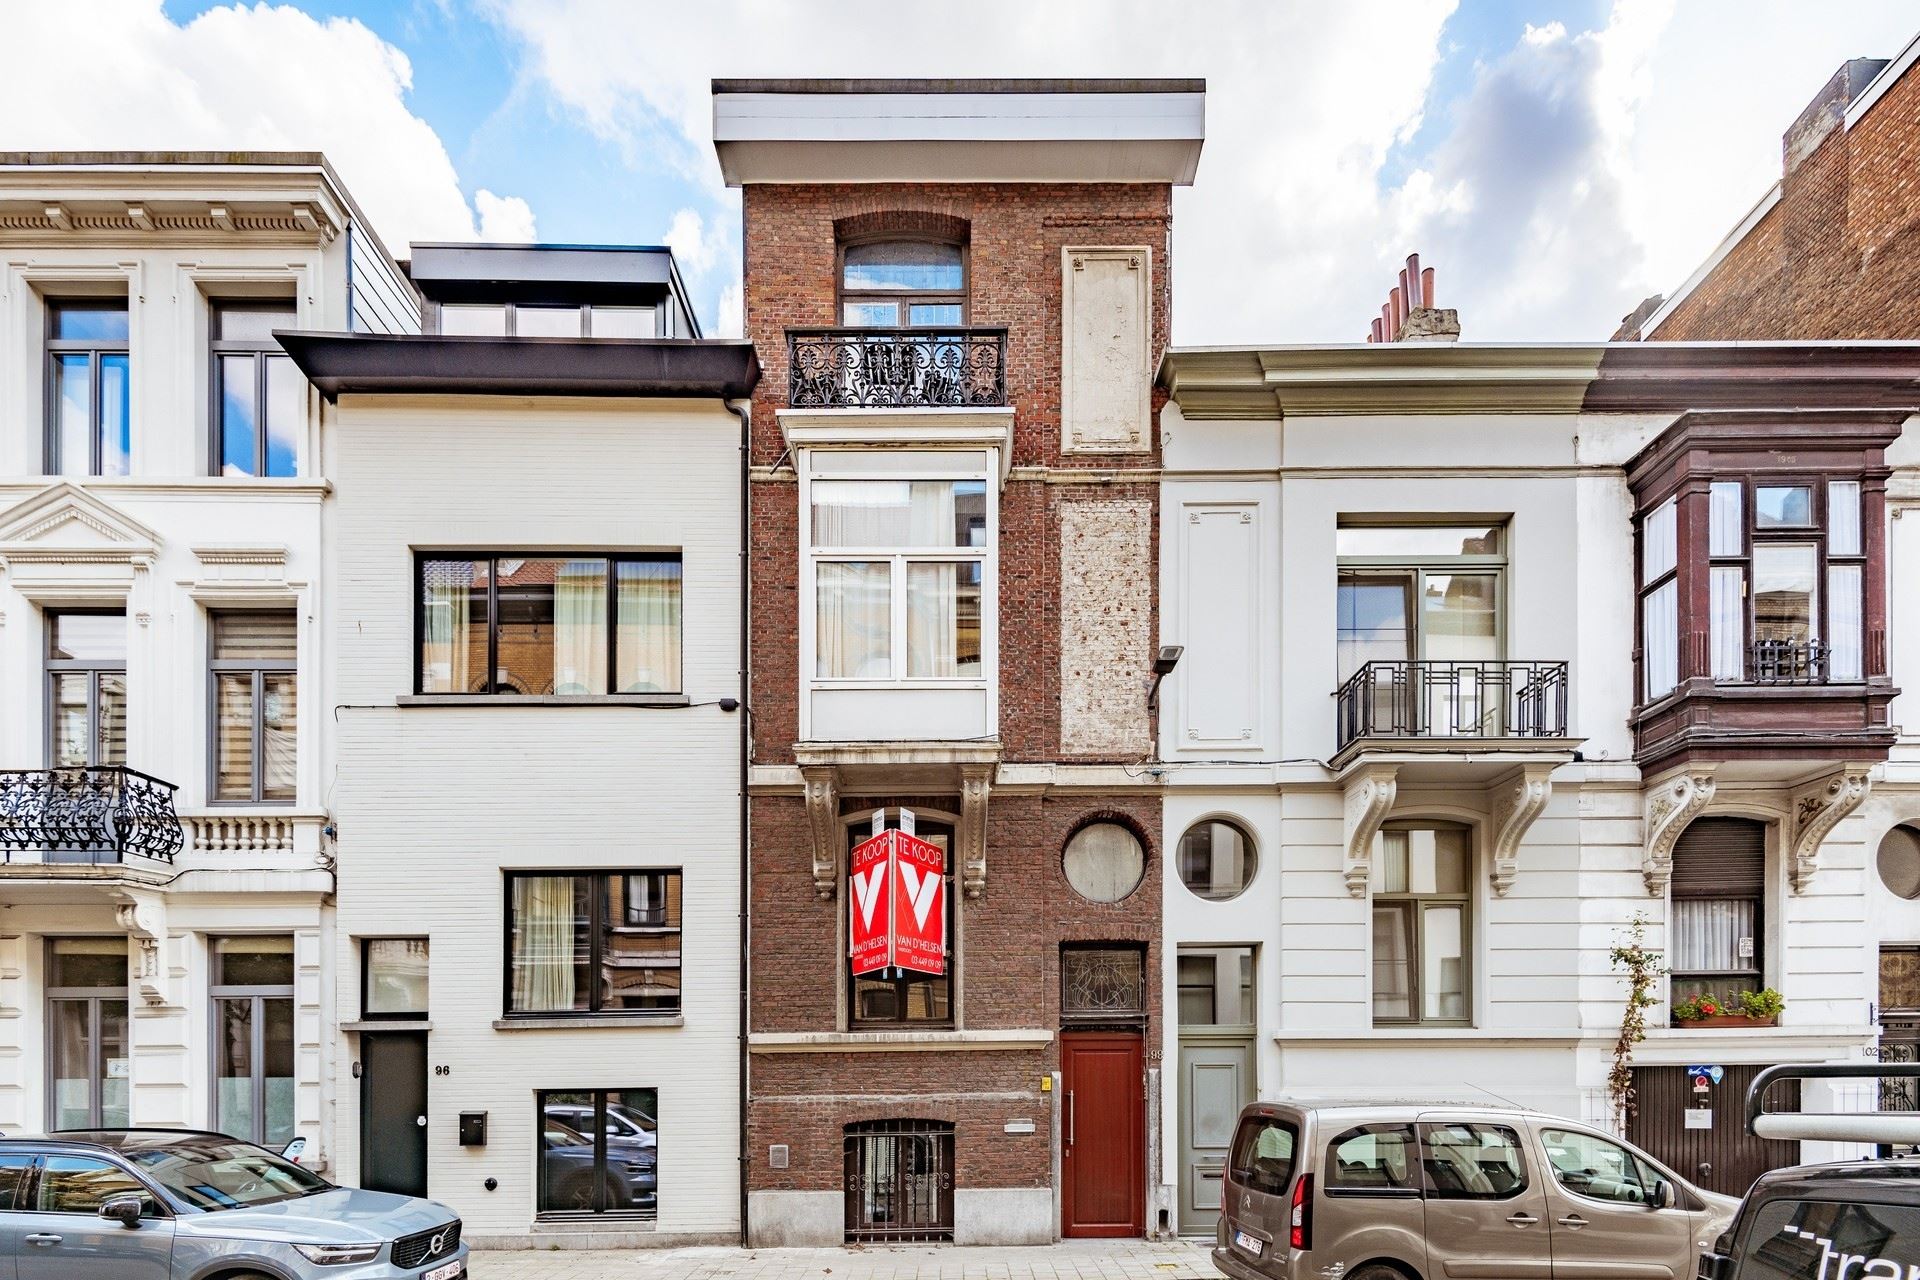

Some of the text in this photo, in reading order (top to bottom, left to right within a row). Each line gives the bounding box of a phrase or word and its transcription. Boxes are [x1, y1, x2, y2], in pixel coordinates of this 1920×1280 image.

[852, 837, 888, 867] TE KOOP
[898, 836, 942, 866] TE KOOP
[897, 935, 911, 947] VAN
[1151, 1050, 1163, 1060] 98
[1862, 1047, 1878, 1057] 102
[435, 1065, 450, 1076] 96
